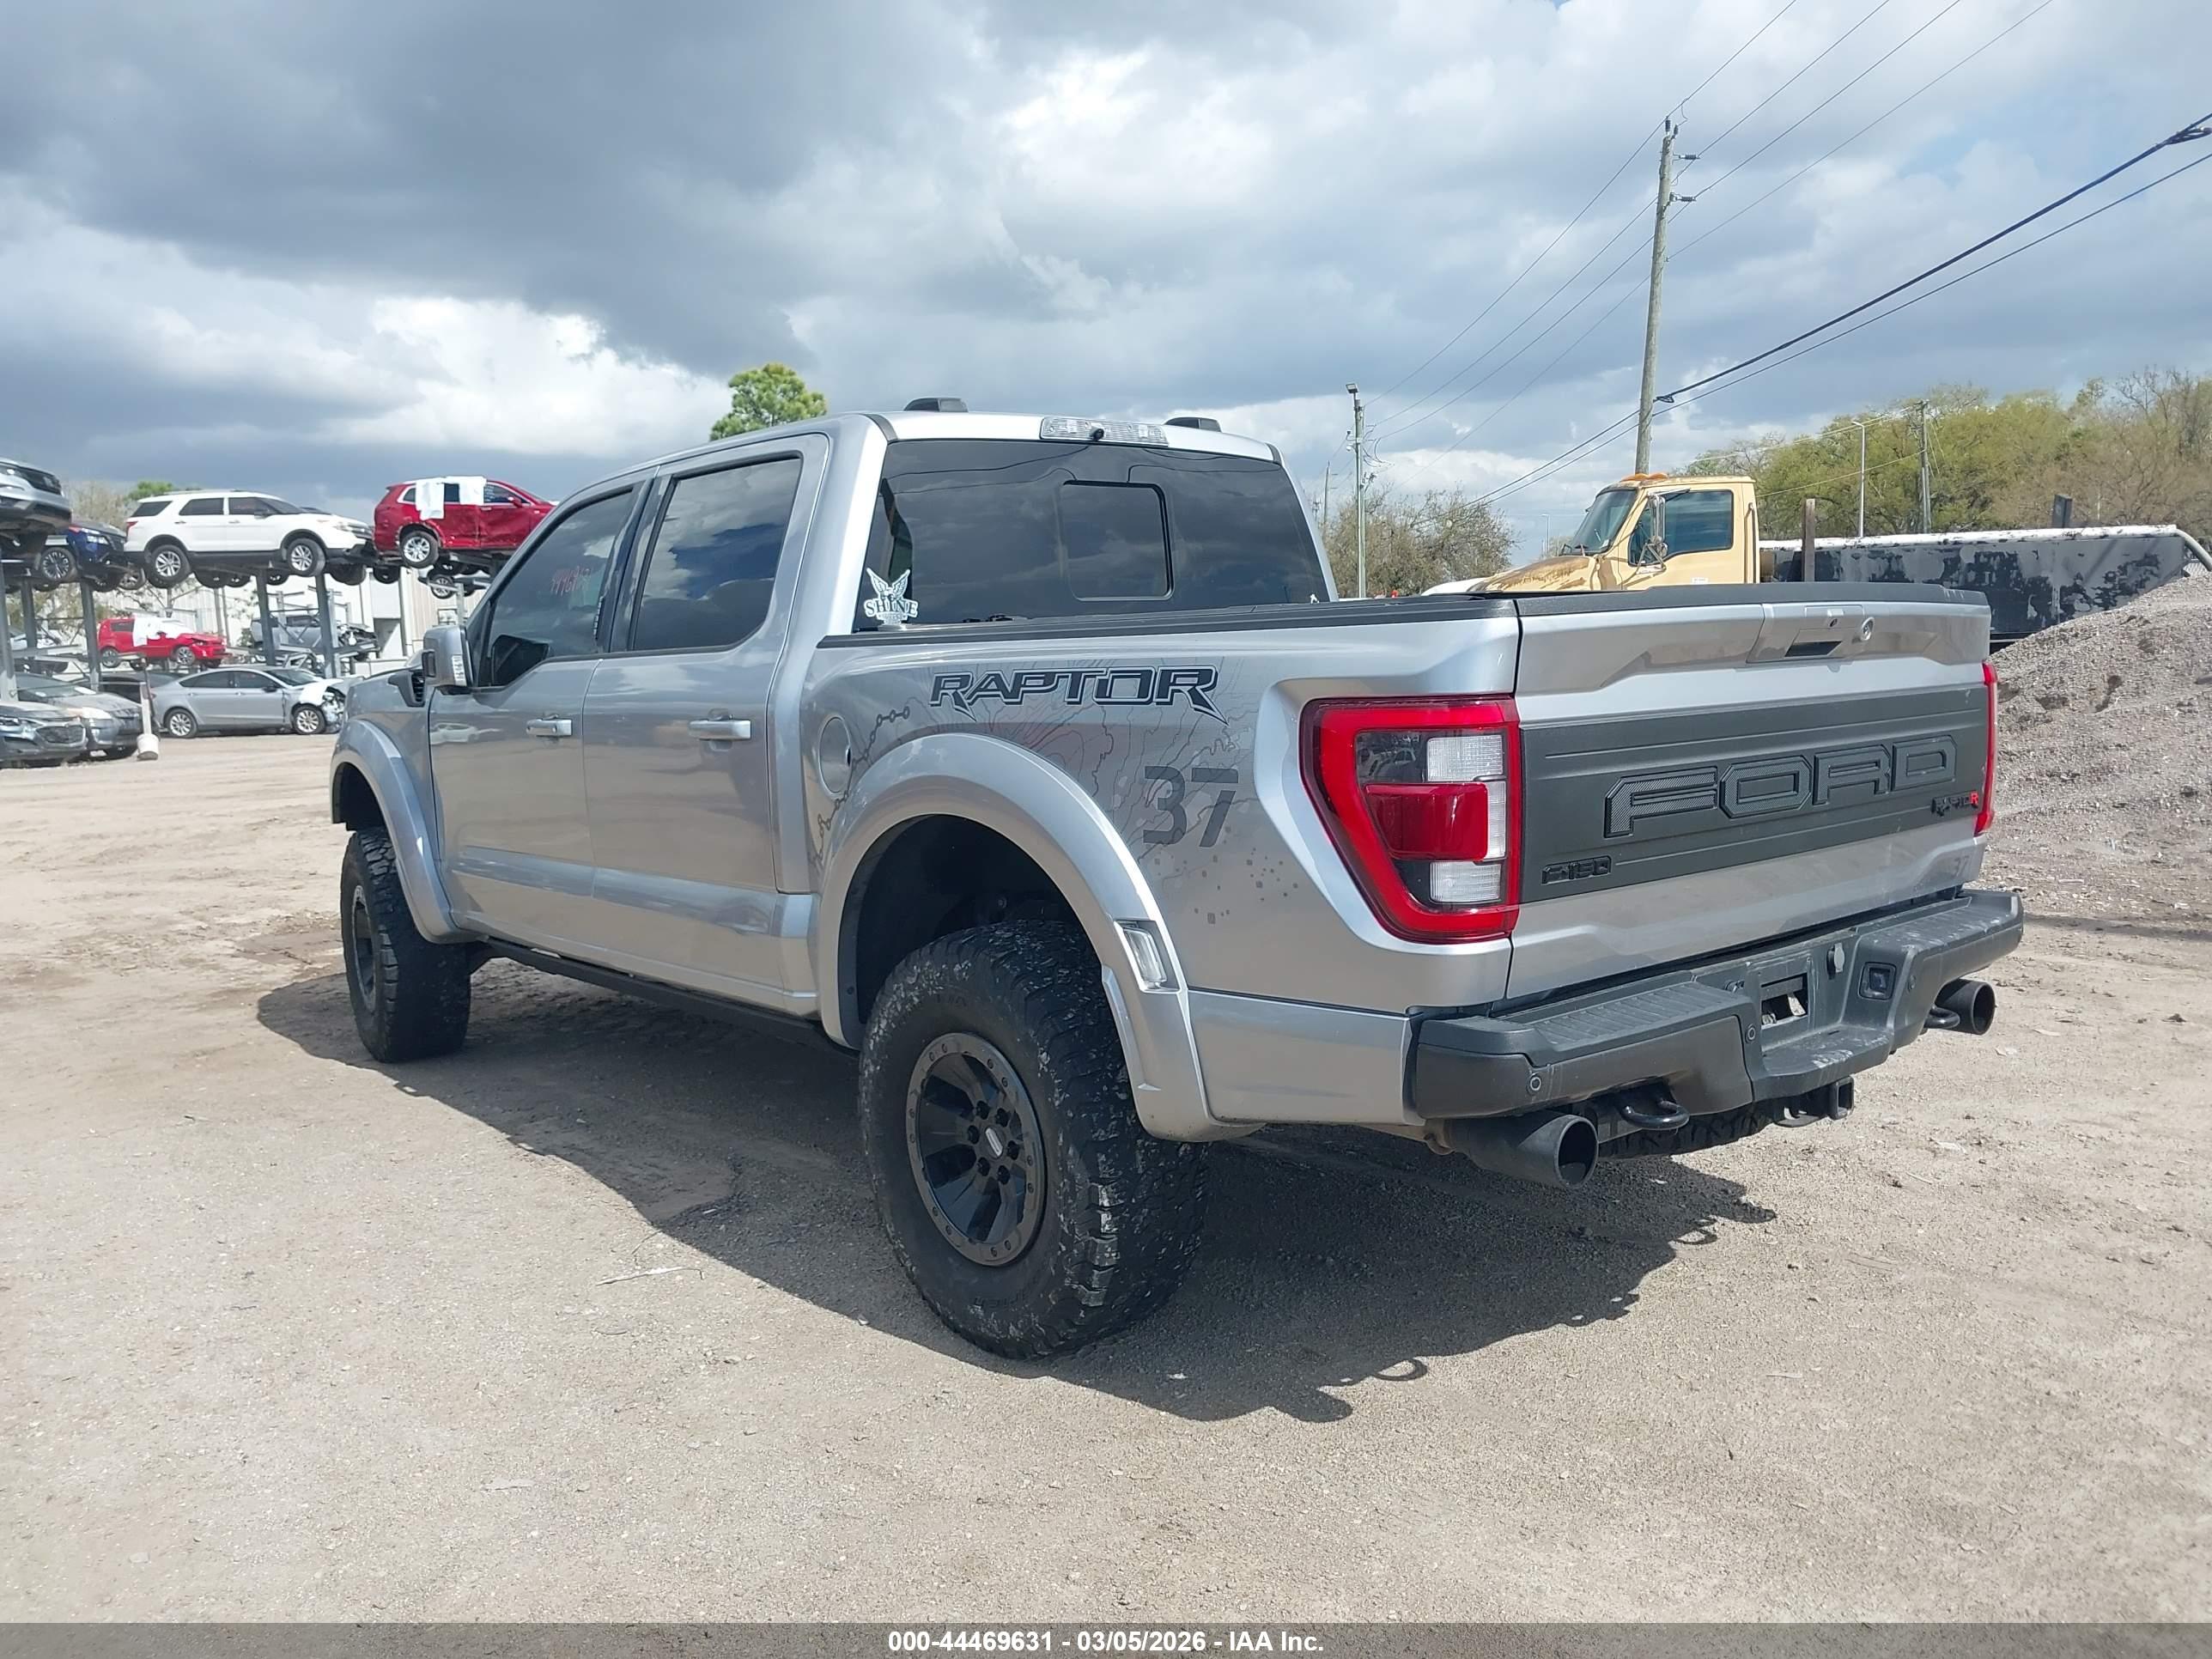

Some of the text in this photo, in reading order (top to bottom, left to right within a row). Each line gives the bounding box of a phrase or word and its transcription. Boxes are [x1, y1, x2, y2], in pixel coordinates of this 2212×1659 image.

[865, 599, 918, 617] SHINE
[928, 665, 1229, 726] RAPTOR
[1143, 765, 1239, 848] 37
[1603, 734, 1958, 838] FORD
